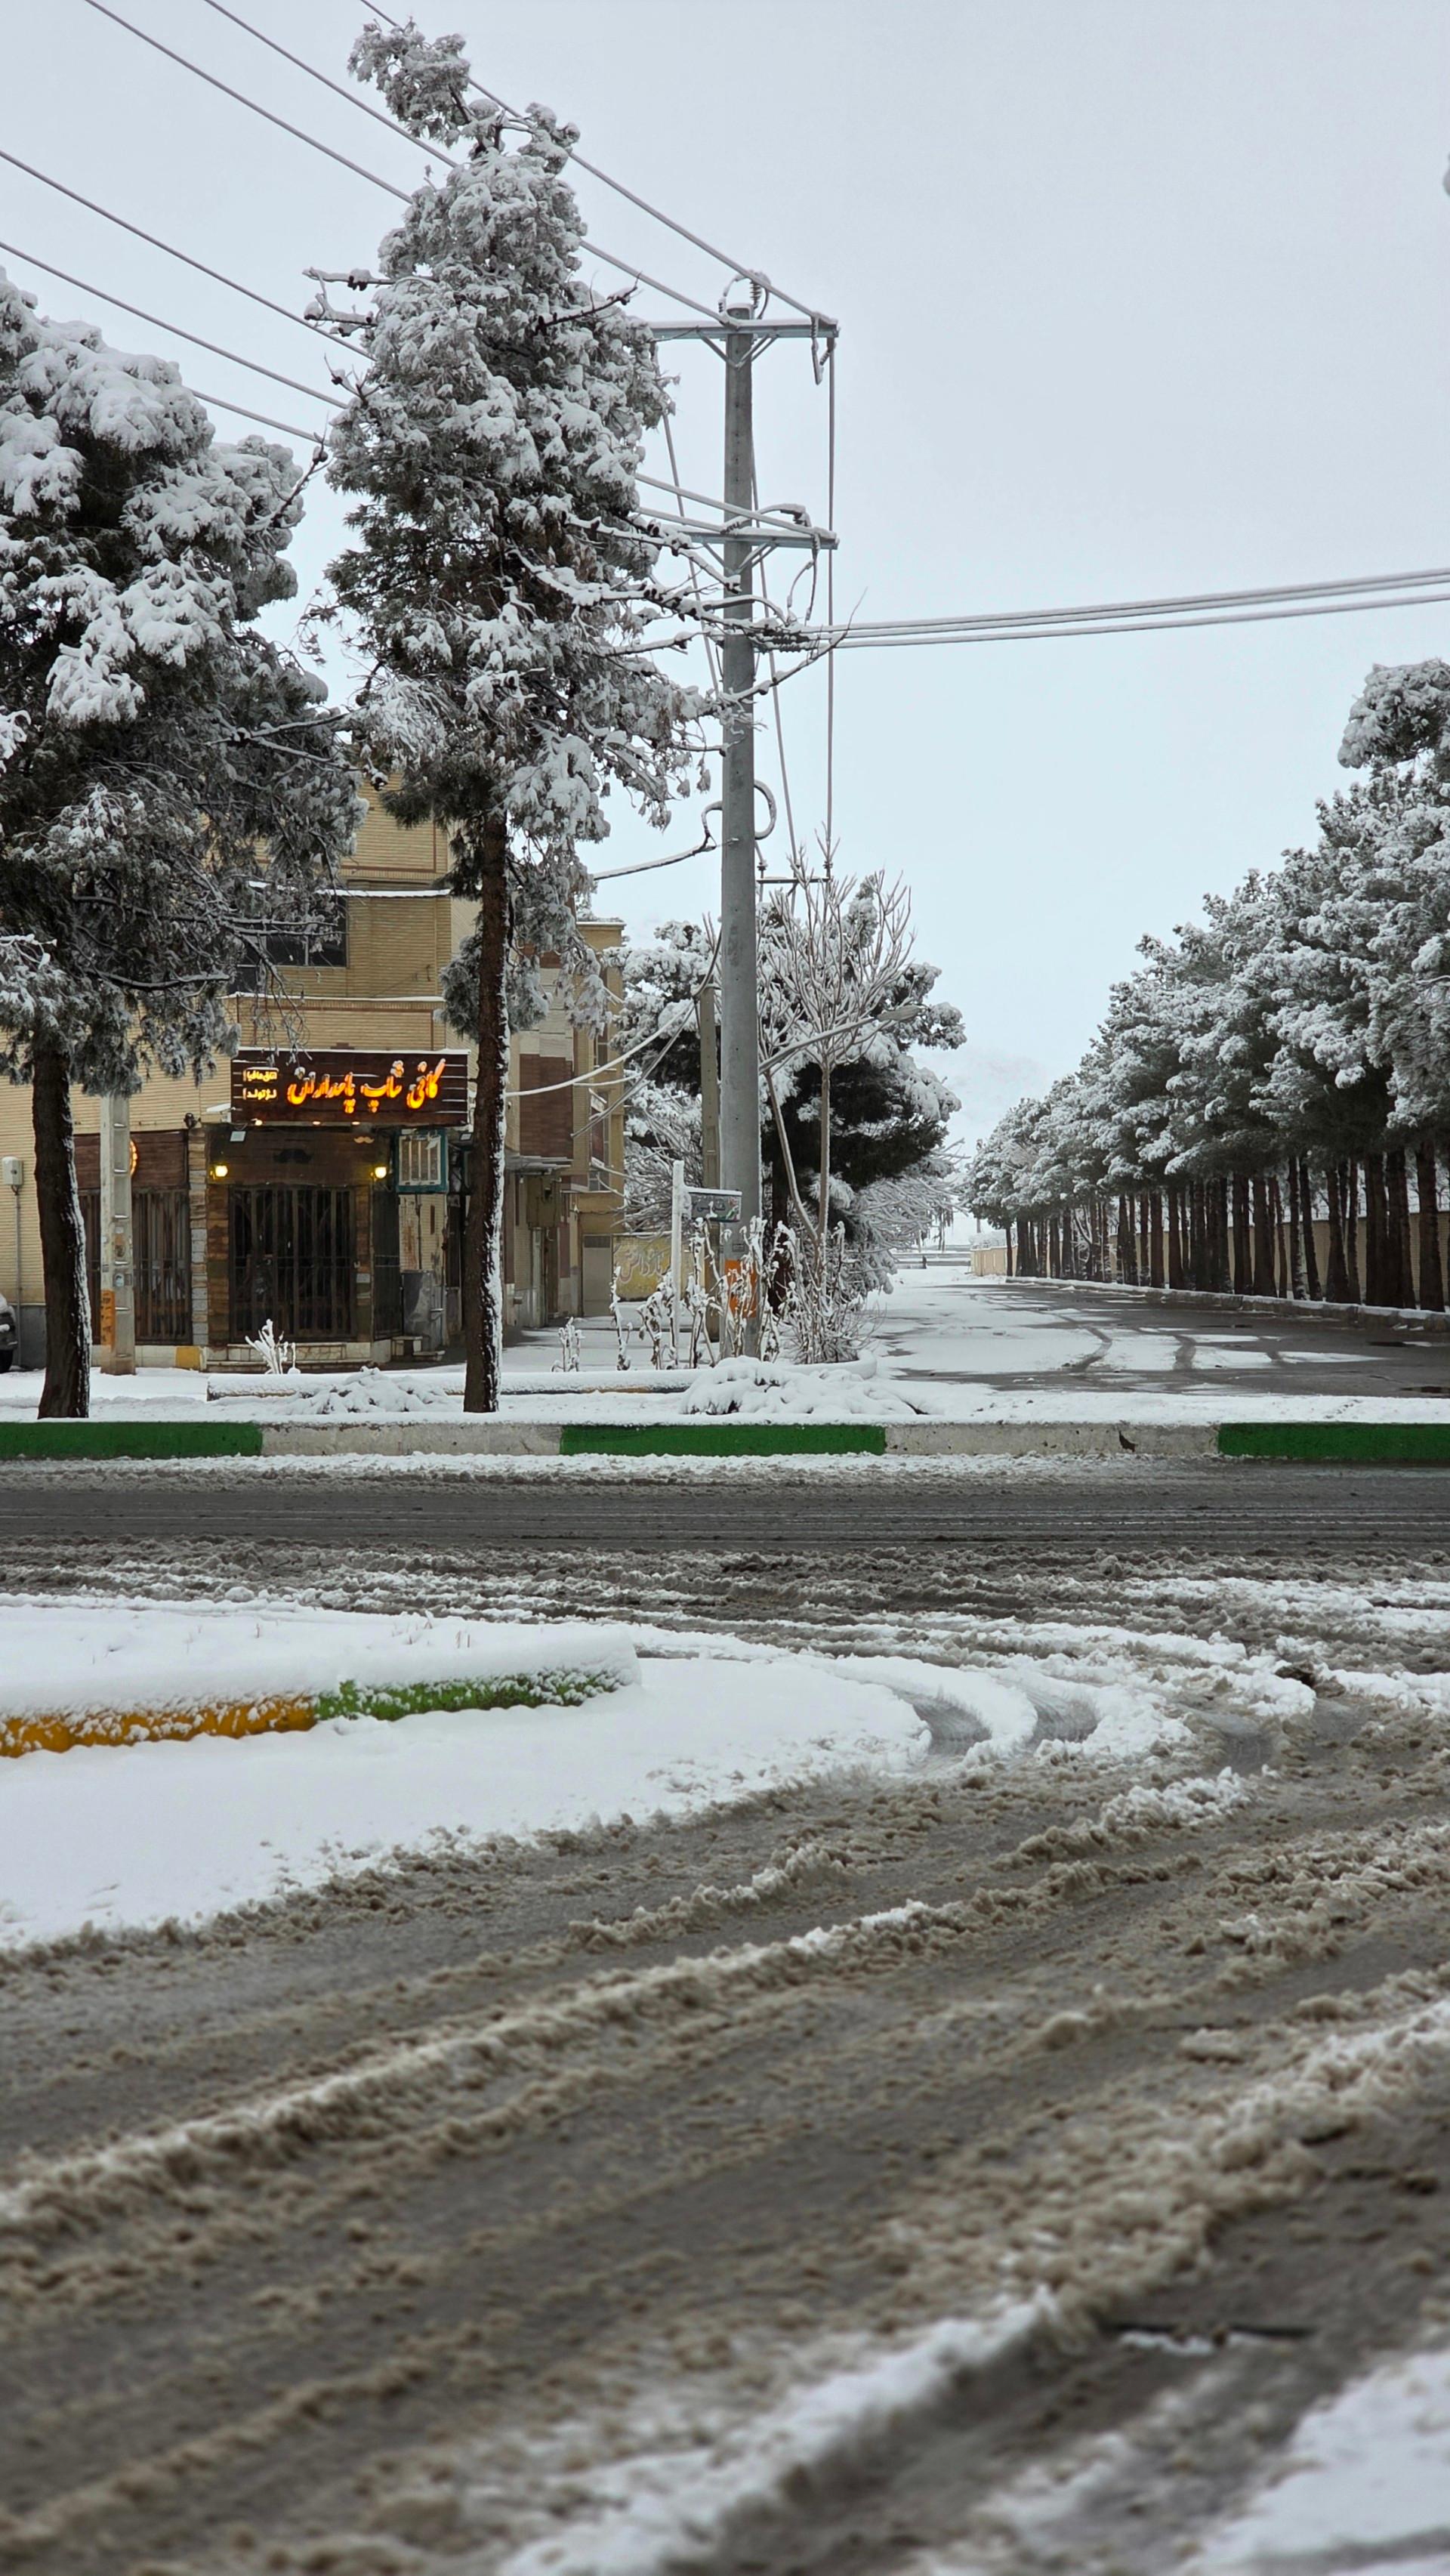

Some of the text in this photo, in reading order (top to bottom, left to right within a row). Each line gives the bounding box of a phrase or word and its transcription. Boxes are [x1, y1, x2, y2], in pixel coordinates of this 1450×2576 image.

[287, 1058, 446, 1113] کافی شاپ پاسداران
